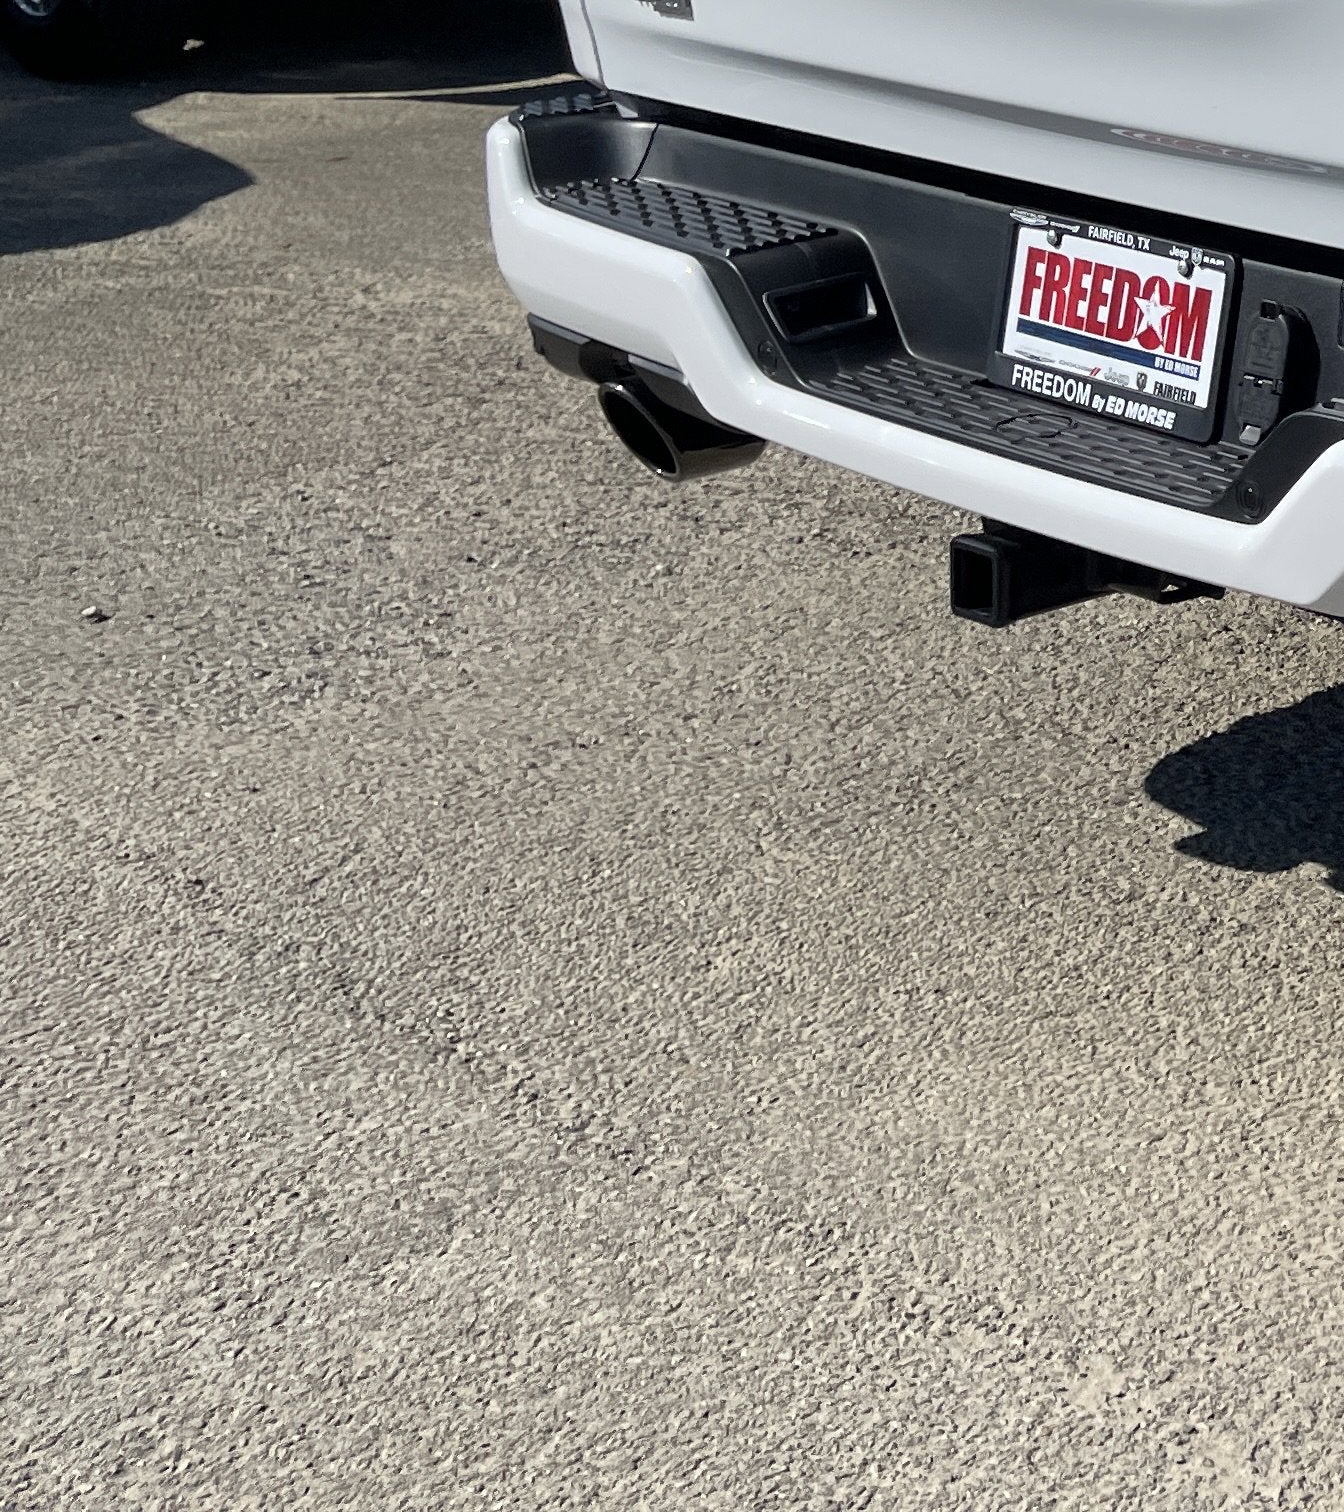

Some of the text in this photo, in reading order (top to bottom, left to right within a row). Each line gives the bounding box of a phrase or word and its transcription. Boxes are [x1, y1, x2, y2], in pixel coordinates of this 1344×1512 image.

[1088, 225, 1136, 248] FAIRFIELD,
[1137, 236, 1151, 250] TX
[1169, 245, 1189, 259] Jeep
[1019, 245, 1213, 362] FREEDOM
[1154, 356, 1199, 377] BY ED MORSE
[1011, 363, 1092, 406] FREEDOM
[1105, 395, 1126, 415] ED
[1124, 400, 1177, 430] MORSE
[1153, 380, 1197, 405] FAIRFIELD
